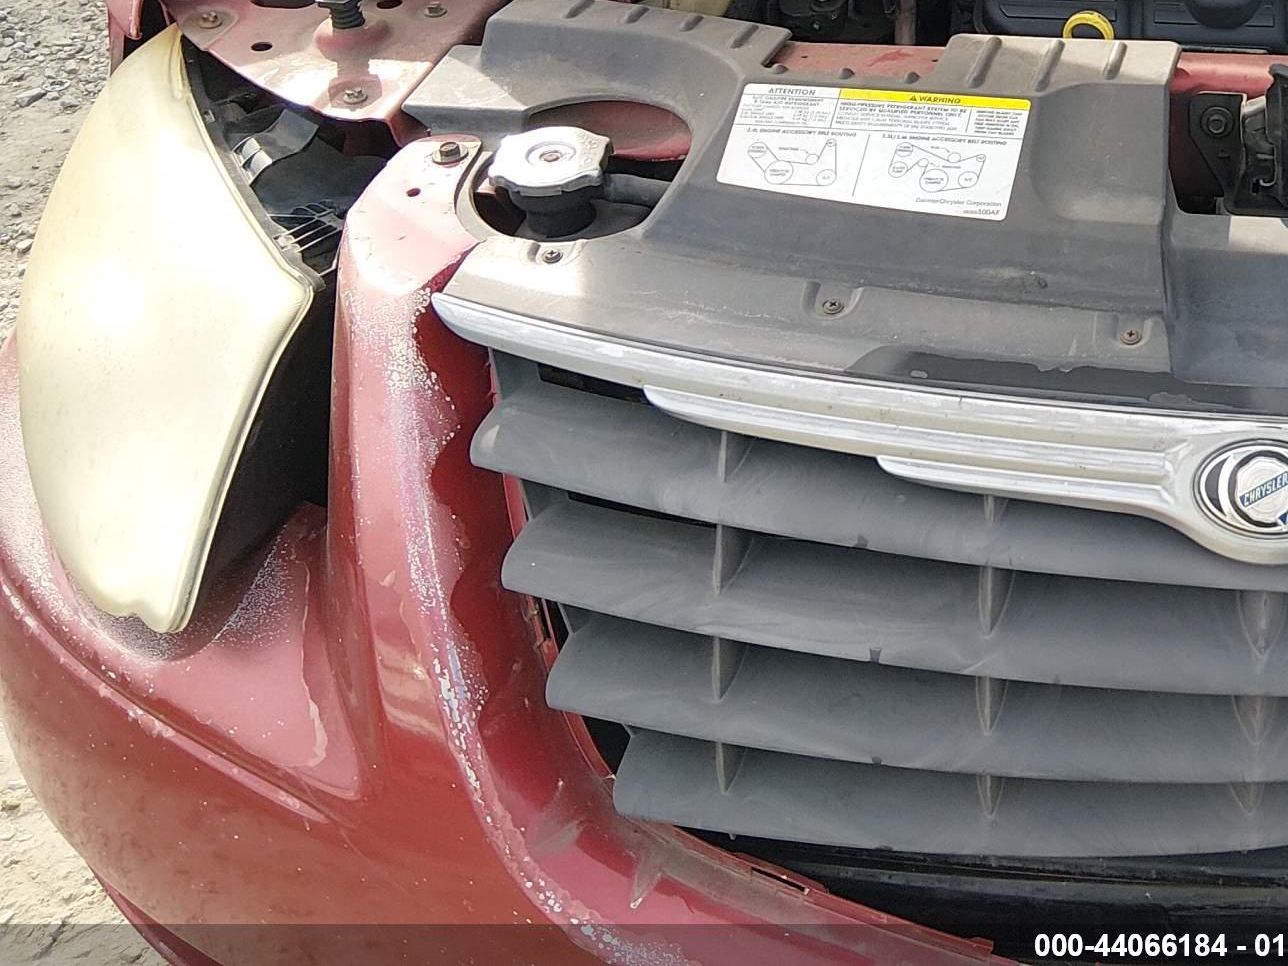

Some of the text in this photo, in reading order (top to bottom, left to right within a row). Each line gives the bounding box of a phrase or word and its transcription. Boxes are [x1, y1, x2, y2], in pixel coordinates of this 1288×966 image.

[768, 87, 816, 96] ATTENTION
[919, 95, 961, 104] WARNING
[1243, 471, 1288, 506] CHRYSLER
